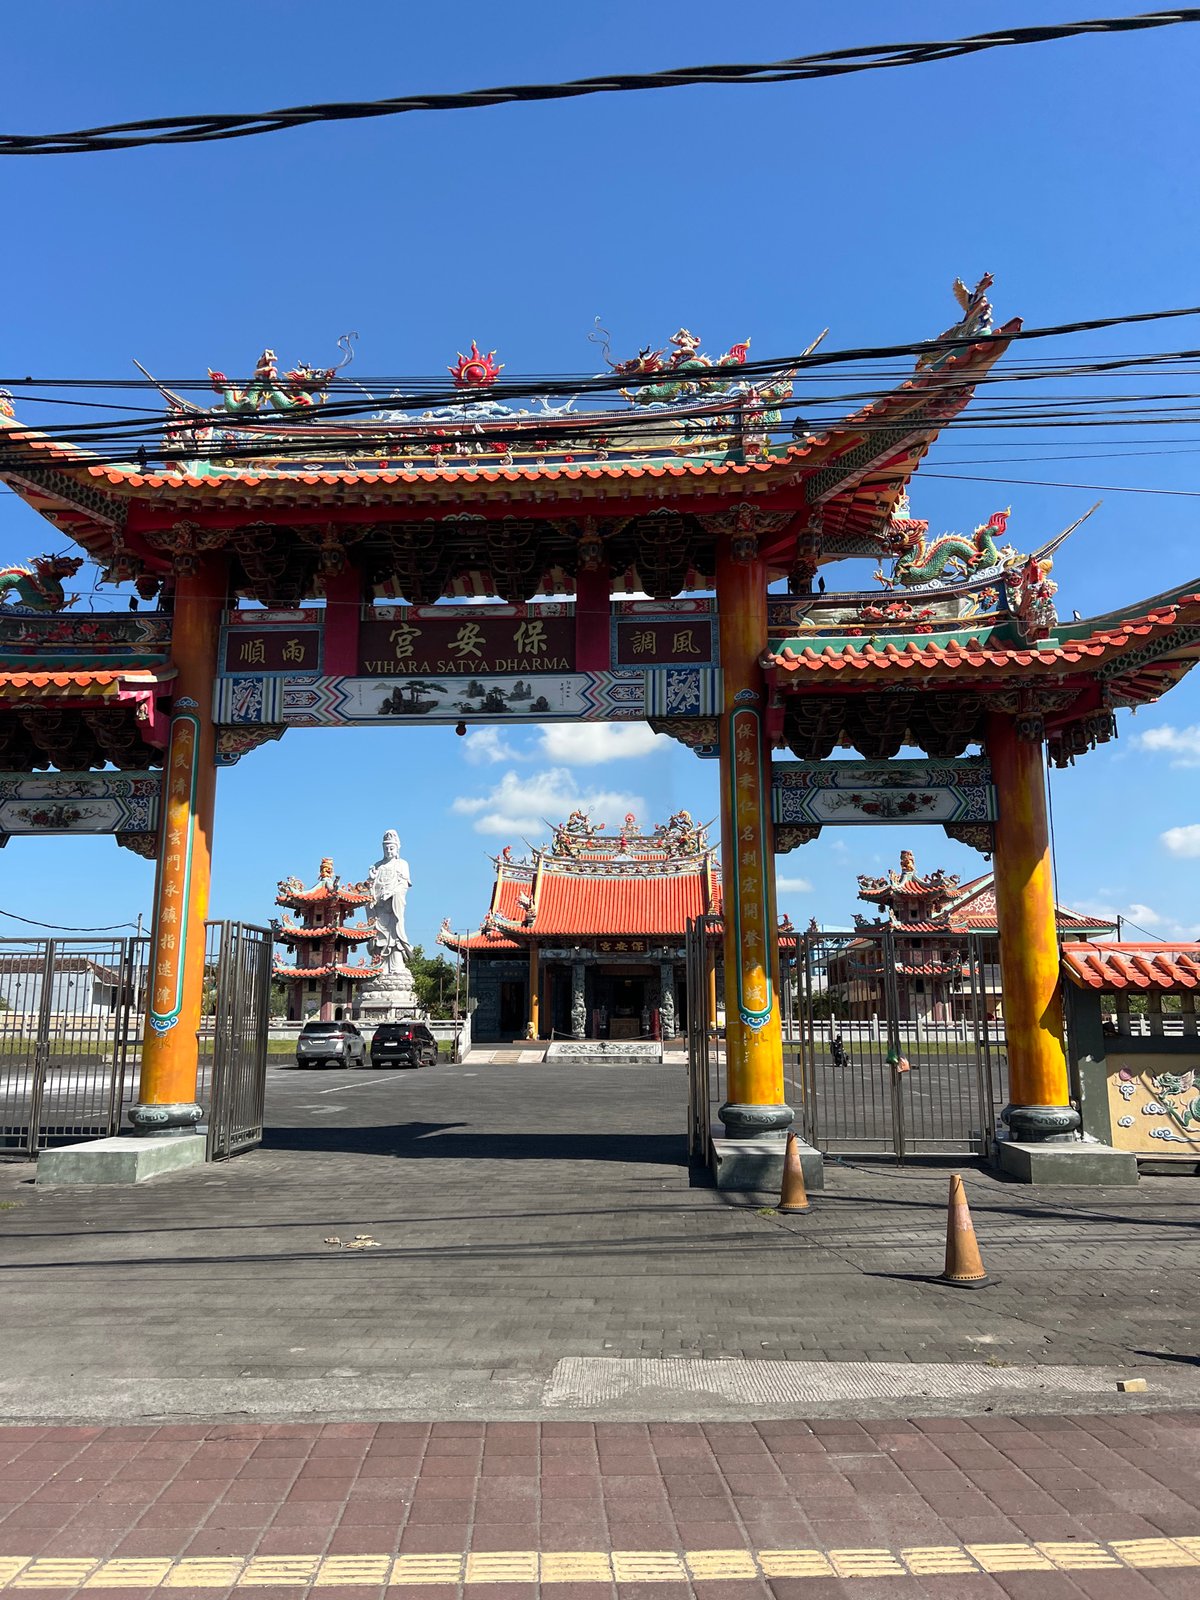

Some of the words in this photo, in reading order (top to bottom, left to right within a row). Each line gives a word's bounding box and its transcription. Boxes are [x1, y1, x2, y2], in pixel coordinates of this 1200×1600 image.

[364, 660, 431, 673] VIHARA
[437, 659, 491, 672] SATYA
[494, 657, 571, 672] DHARMA
